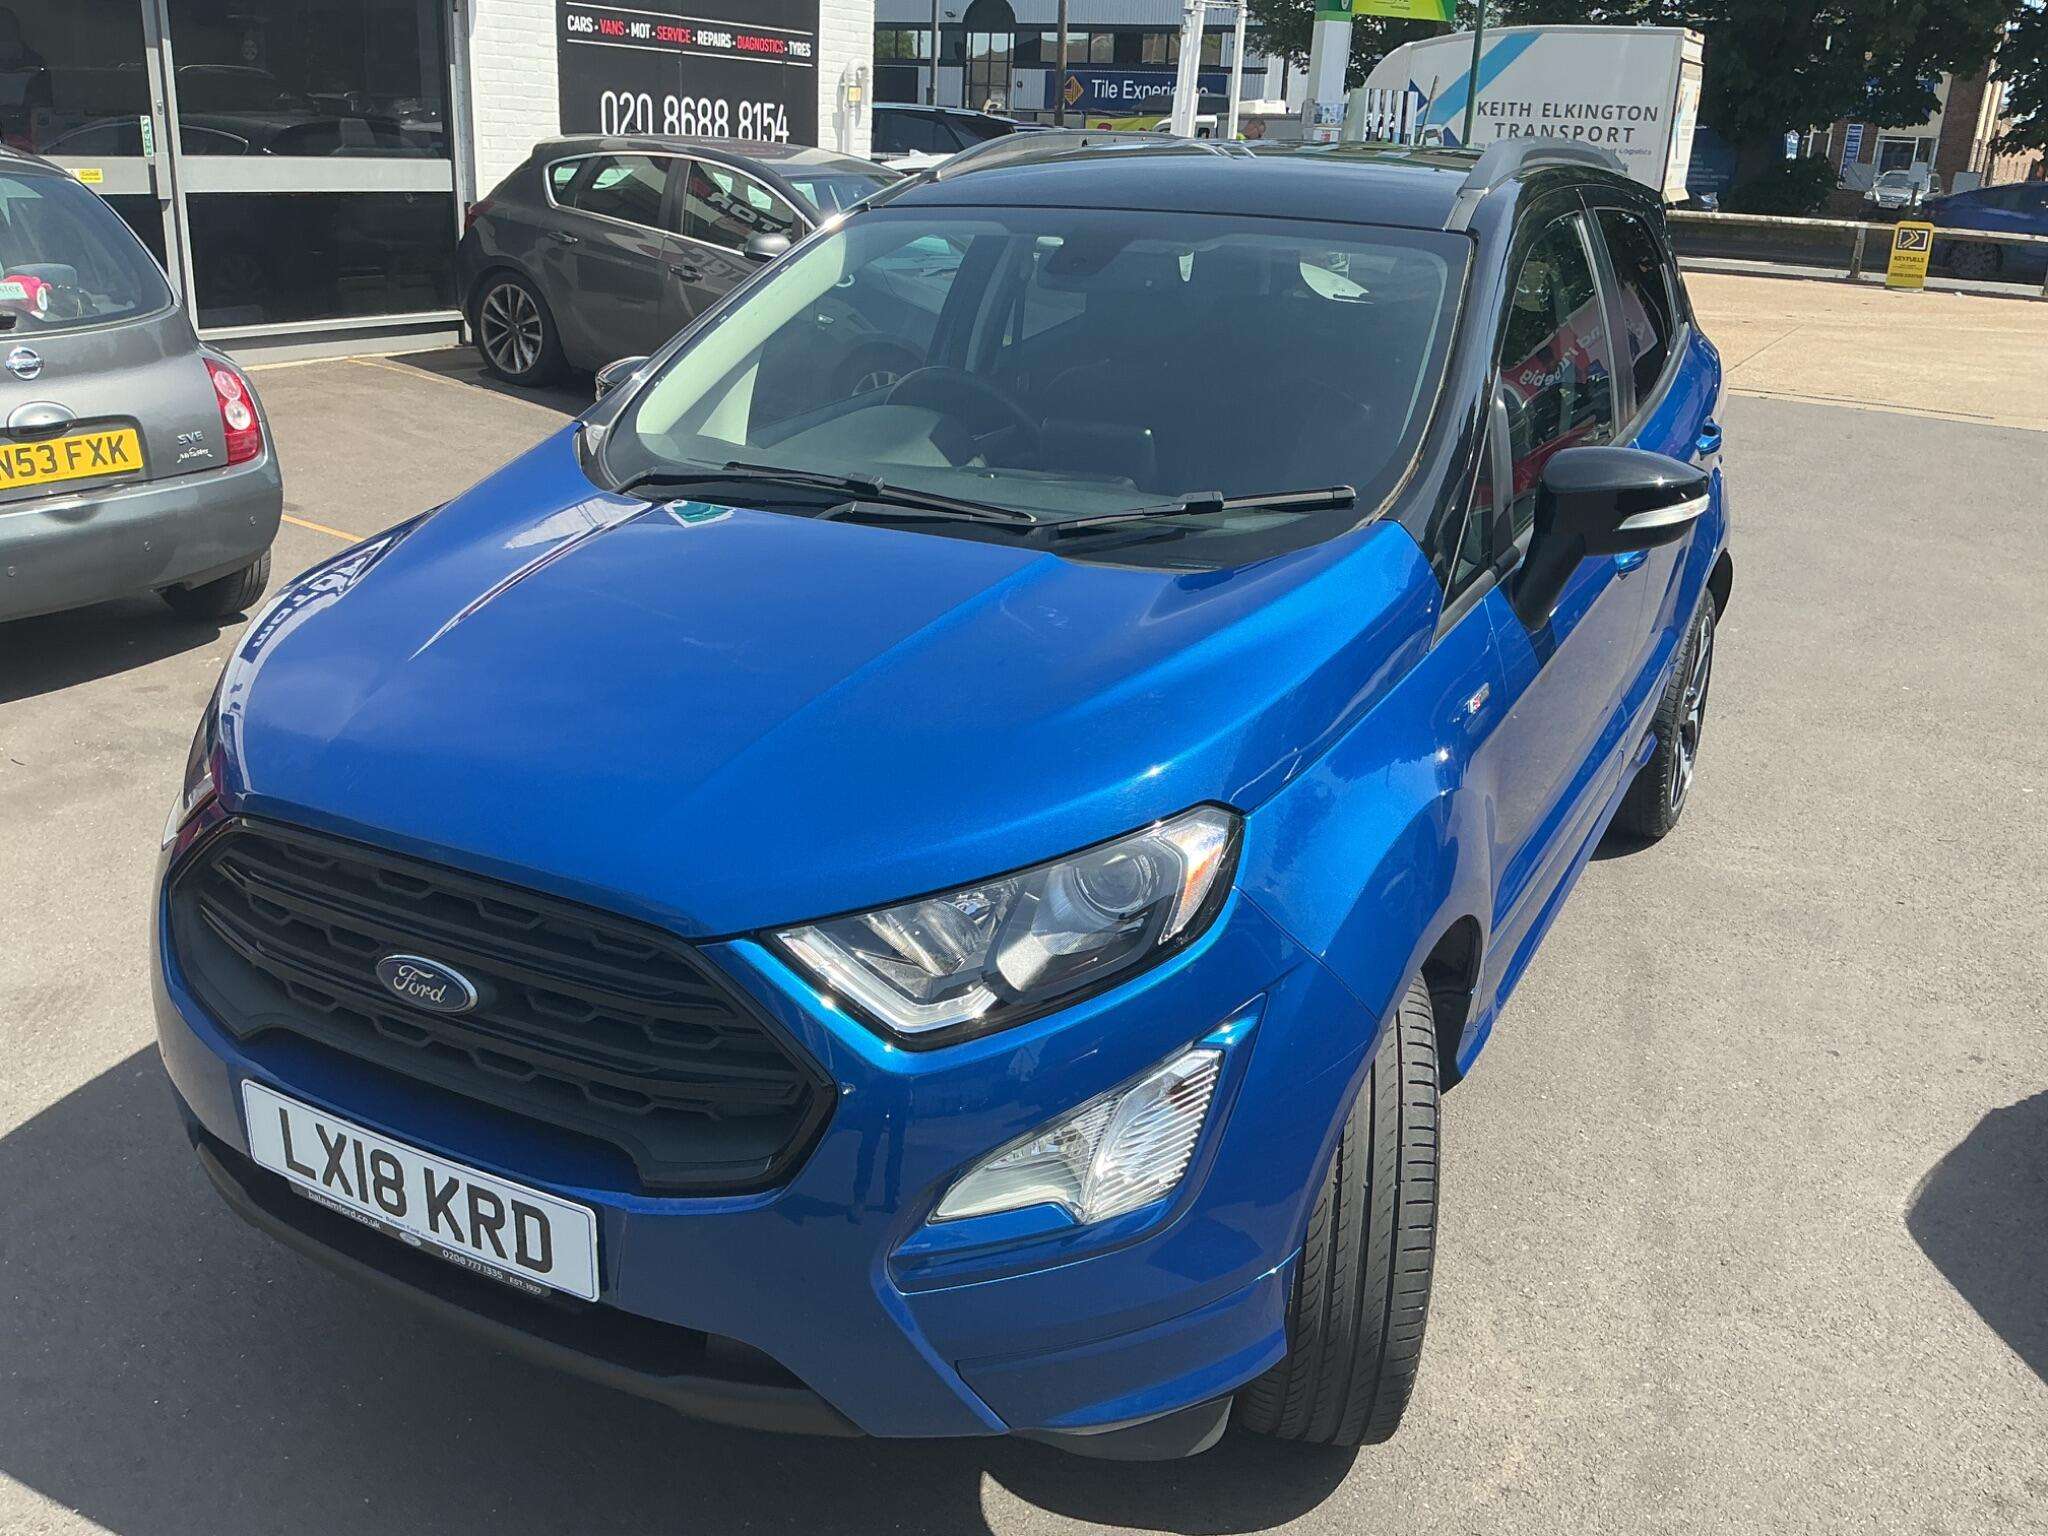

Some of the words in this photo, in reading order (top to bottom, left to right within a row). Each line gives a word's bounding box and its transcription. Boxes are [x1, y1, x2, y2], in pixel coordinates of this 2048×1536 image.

[567, 15, 593, 33] CARS
[600, 19, 624, 36] VANS
[631, 23, 651, 39] MOT
[657, 26, 691, 44] SERVICE
[697, 30, 732, 48] REPAIRS
[737, 35, 784, 54] DIAGNOSTICS
[788, 40, 812, 57] TYRES
[1091, 79, 1118, 98] Tile
[1122, 80, 1208, 99] Experiee
[600, 90, 653, 136] 020
[663, 94, 729, 137] 8688
[738, 100, 790, 144] 8154
[1477, 101, 1532, 117] KEITH
[1541, 103, 1658, 122] ELKINGTON
[1494, 122, 1635, 143] TRANSPORT
[65, 435, 128, 470] FXK
[393, 964, 447, 1003] Ford
[278, 1107, 407, 1218] LX18
[423, 1167, 553, 1274] KRD
